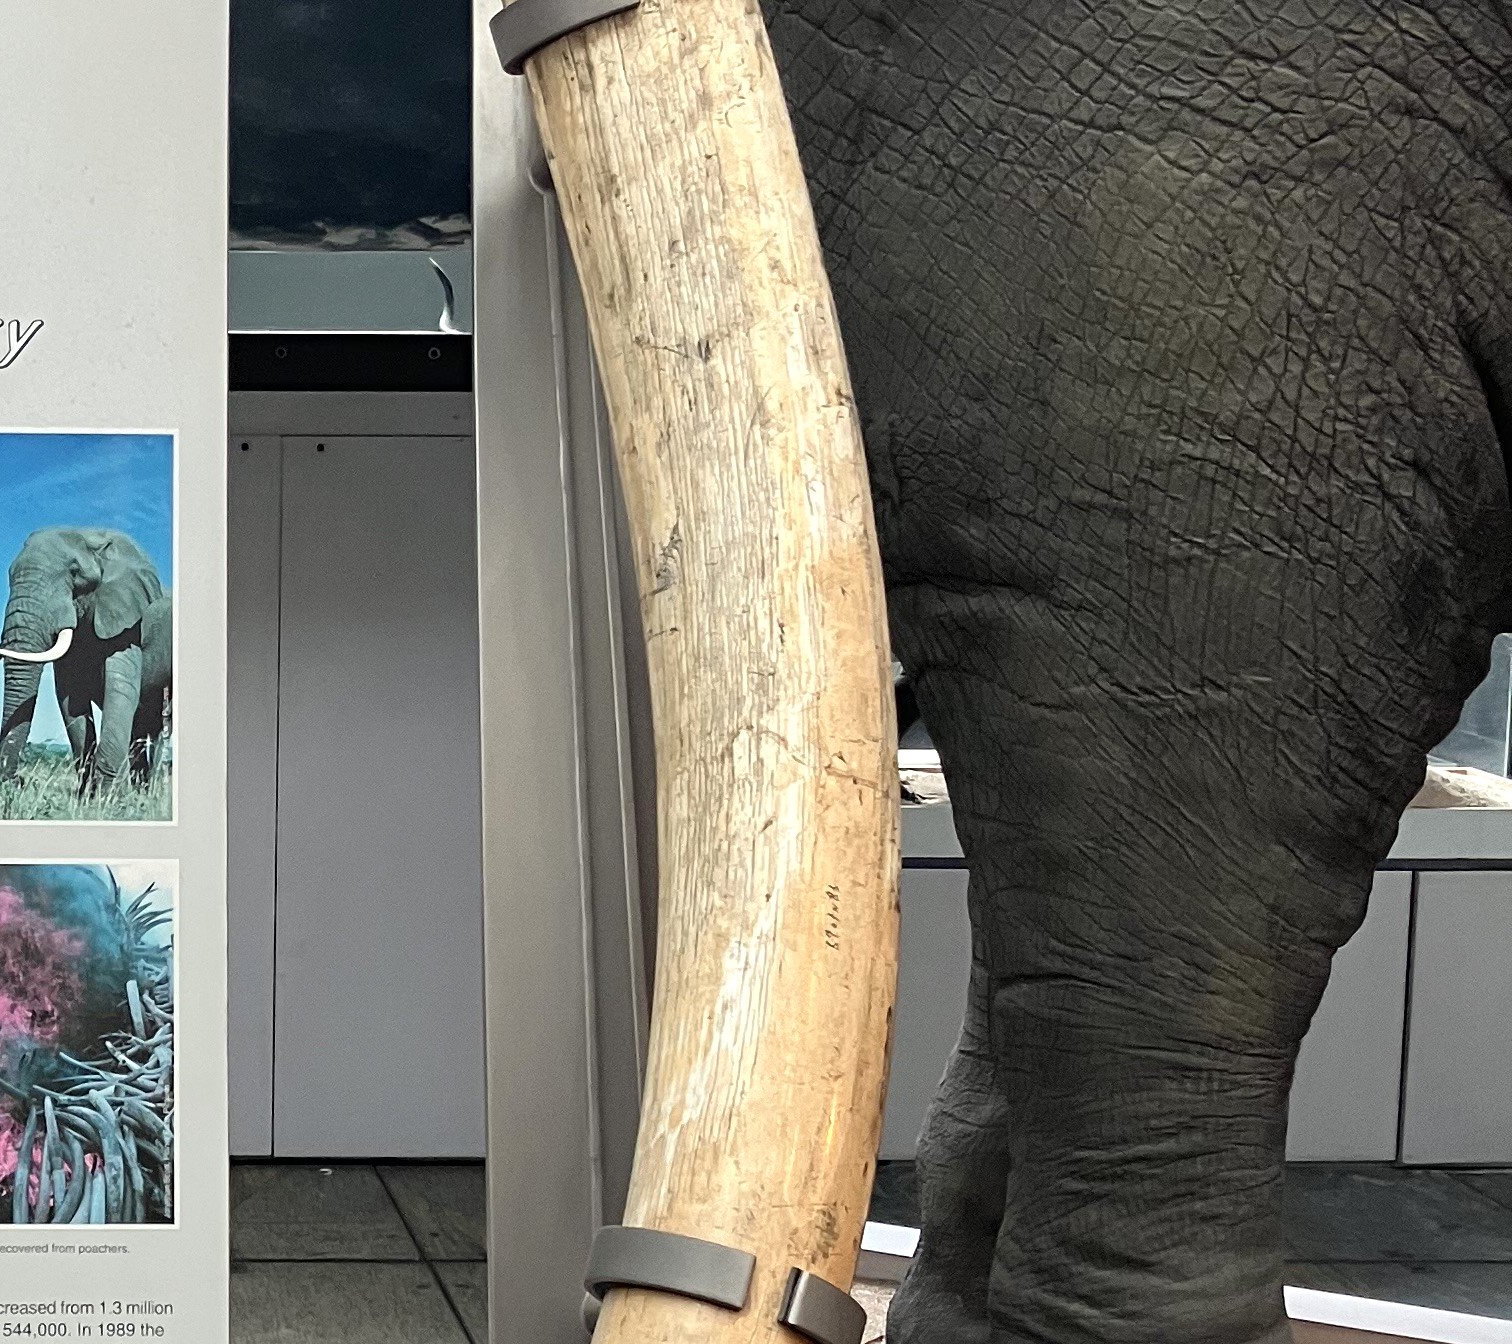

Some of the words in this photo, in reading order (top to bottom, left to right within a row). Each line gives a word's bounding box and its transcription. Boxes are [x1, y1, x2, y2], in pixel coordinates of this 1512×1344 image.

[52, 1242, 75, 1254] from
[78, 1244, 130, 1256] poachers.
[61, 1301, 94, 1315] from
[126, 1300, 173, 1315] million
[3, 1322, 71, 1339] 544,000.
[78, 1322, 91, 1336] In
[98, 1321, 135, 1337] 1989
[141, 1323, 164, 1337] the
